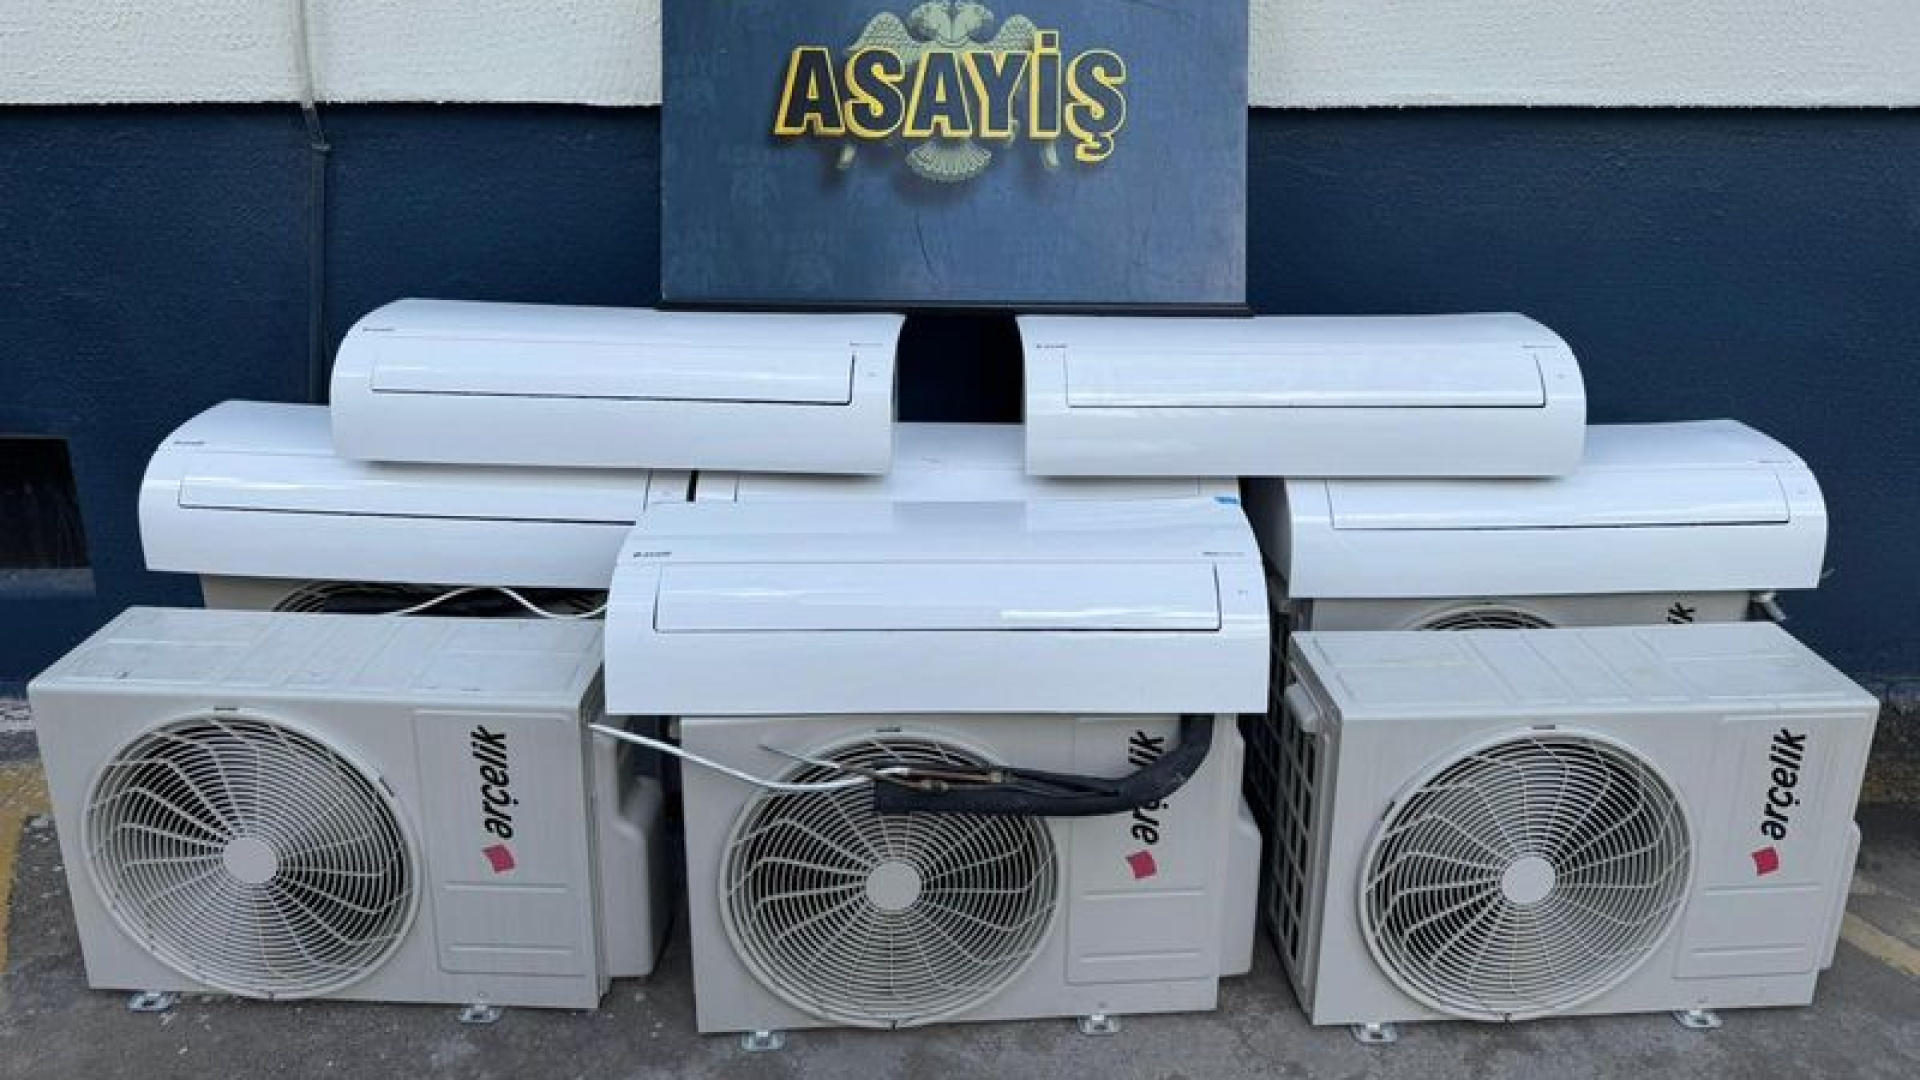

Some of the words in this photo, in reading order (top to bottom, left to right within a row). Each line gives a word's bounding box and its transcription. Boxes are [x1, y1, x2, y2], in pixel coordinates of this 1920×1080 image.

[774, 30, 1126, 162] ASAYİŞ
[470, 724, 518, 840] arçelik
[1760, 726, 1806, 841] arçelik
